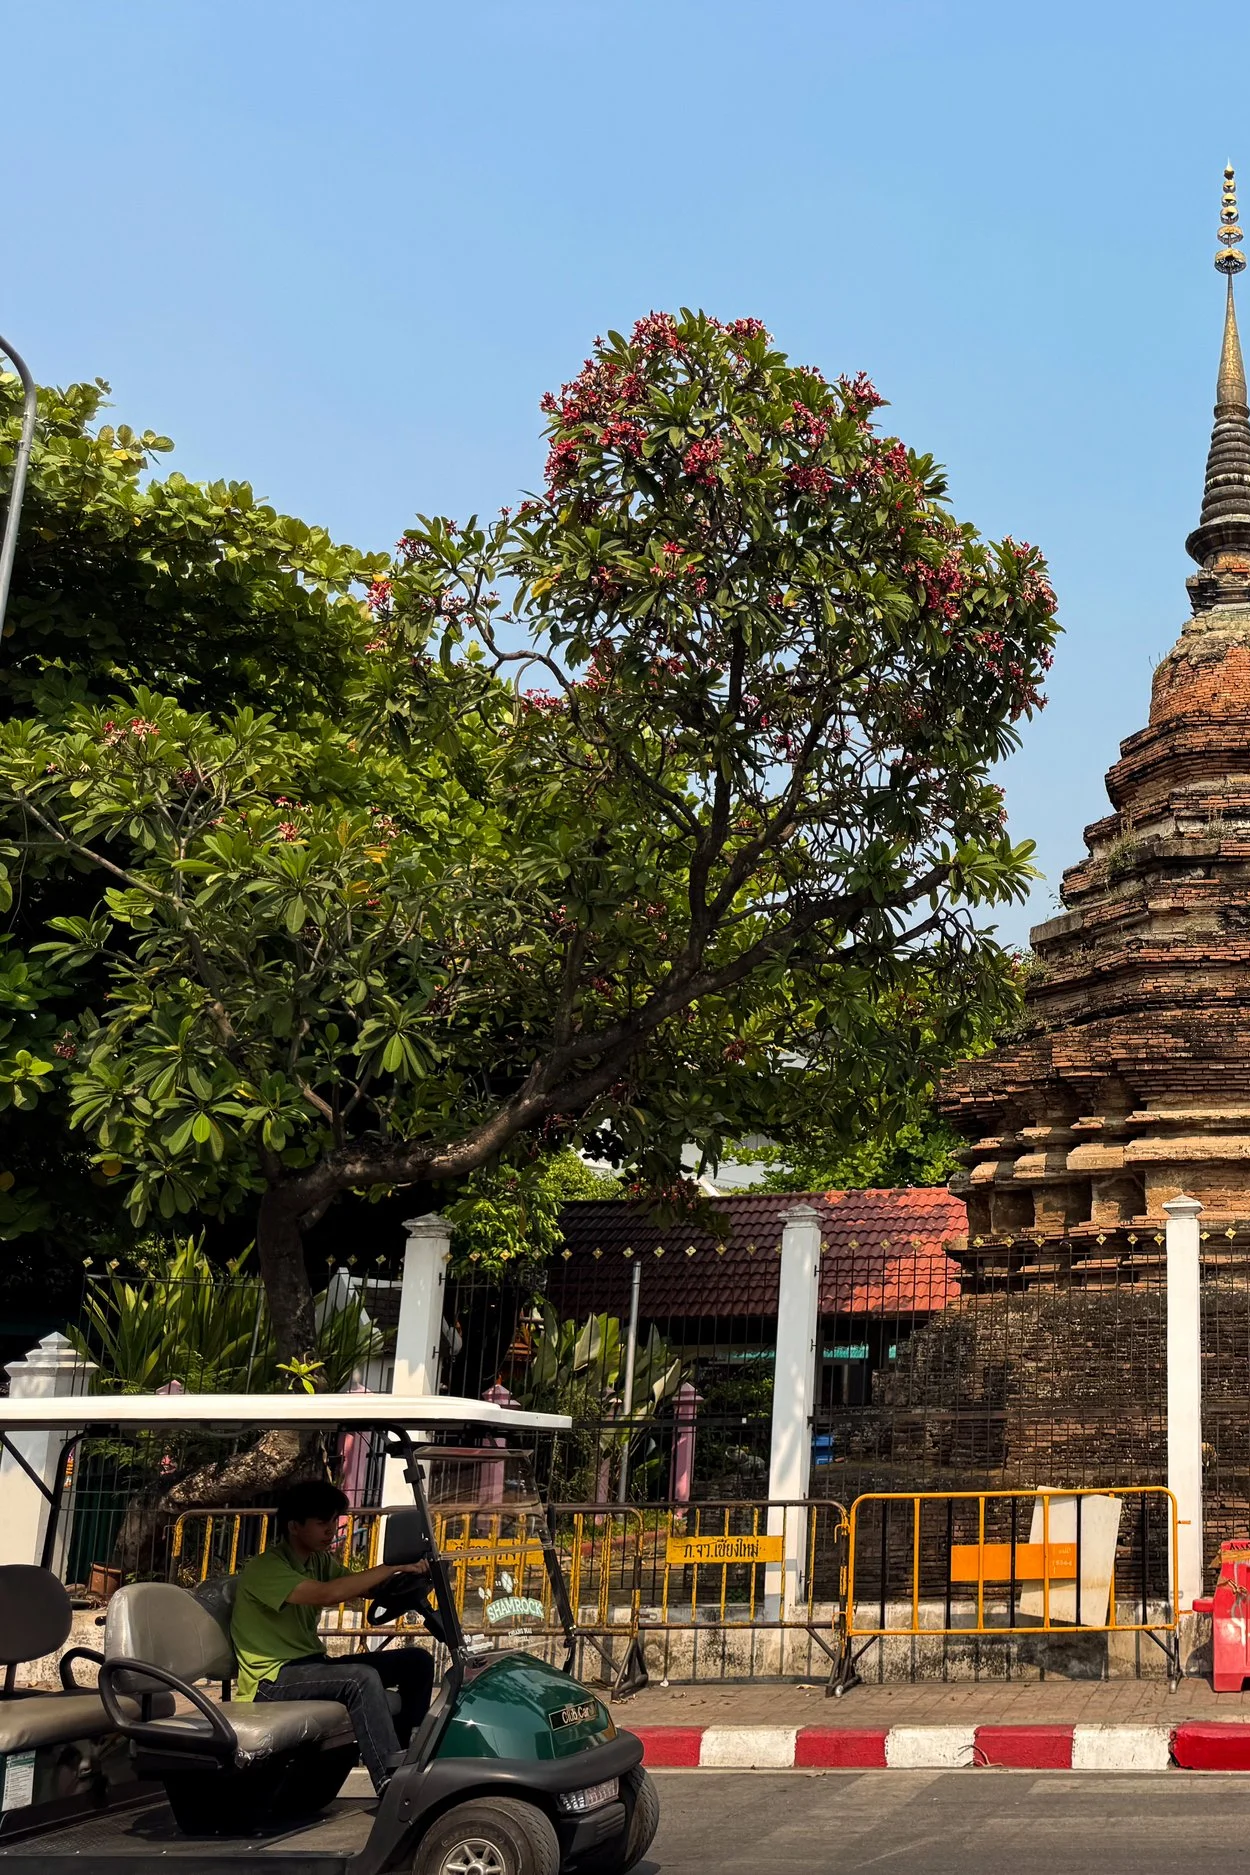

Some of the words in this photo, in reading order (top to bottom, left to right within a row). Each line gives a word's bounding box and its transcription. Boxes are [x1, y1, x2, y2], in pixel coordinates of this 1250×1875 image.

[488, 1598, 544, 1621] SHAMROCK
[562, 1708, 578, 1724] Club
[578, 1706, 590, 1719] Car
